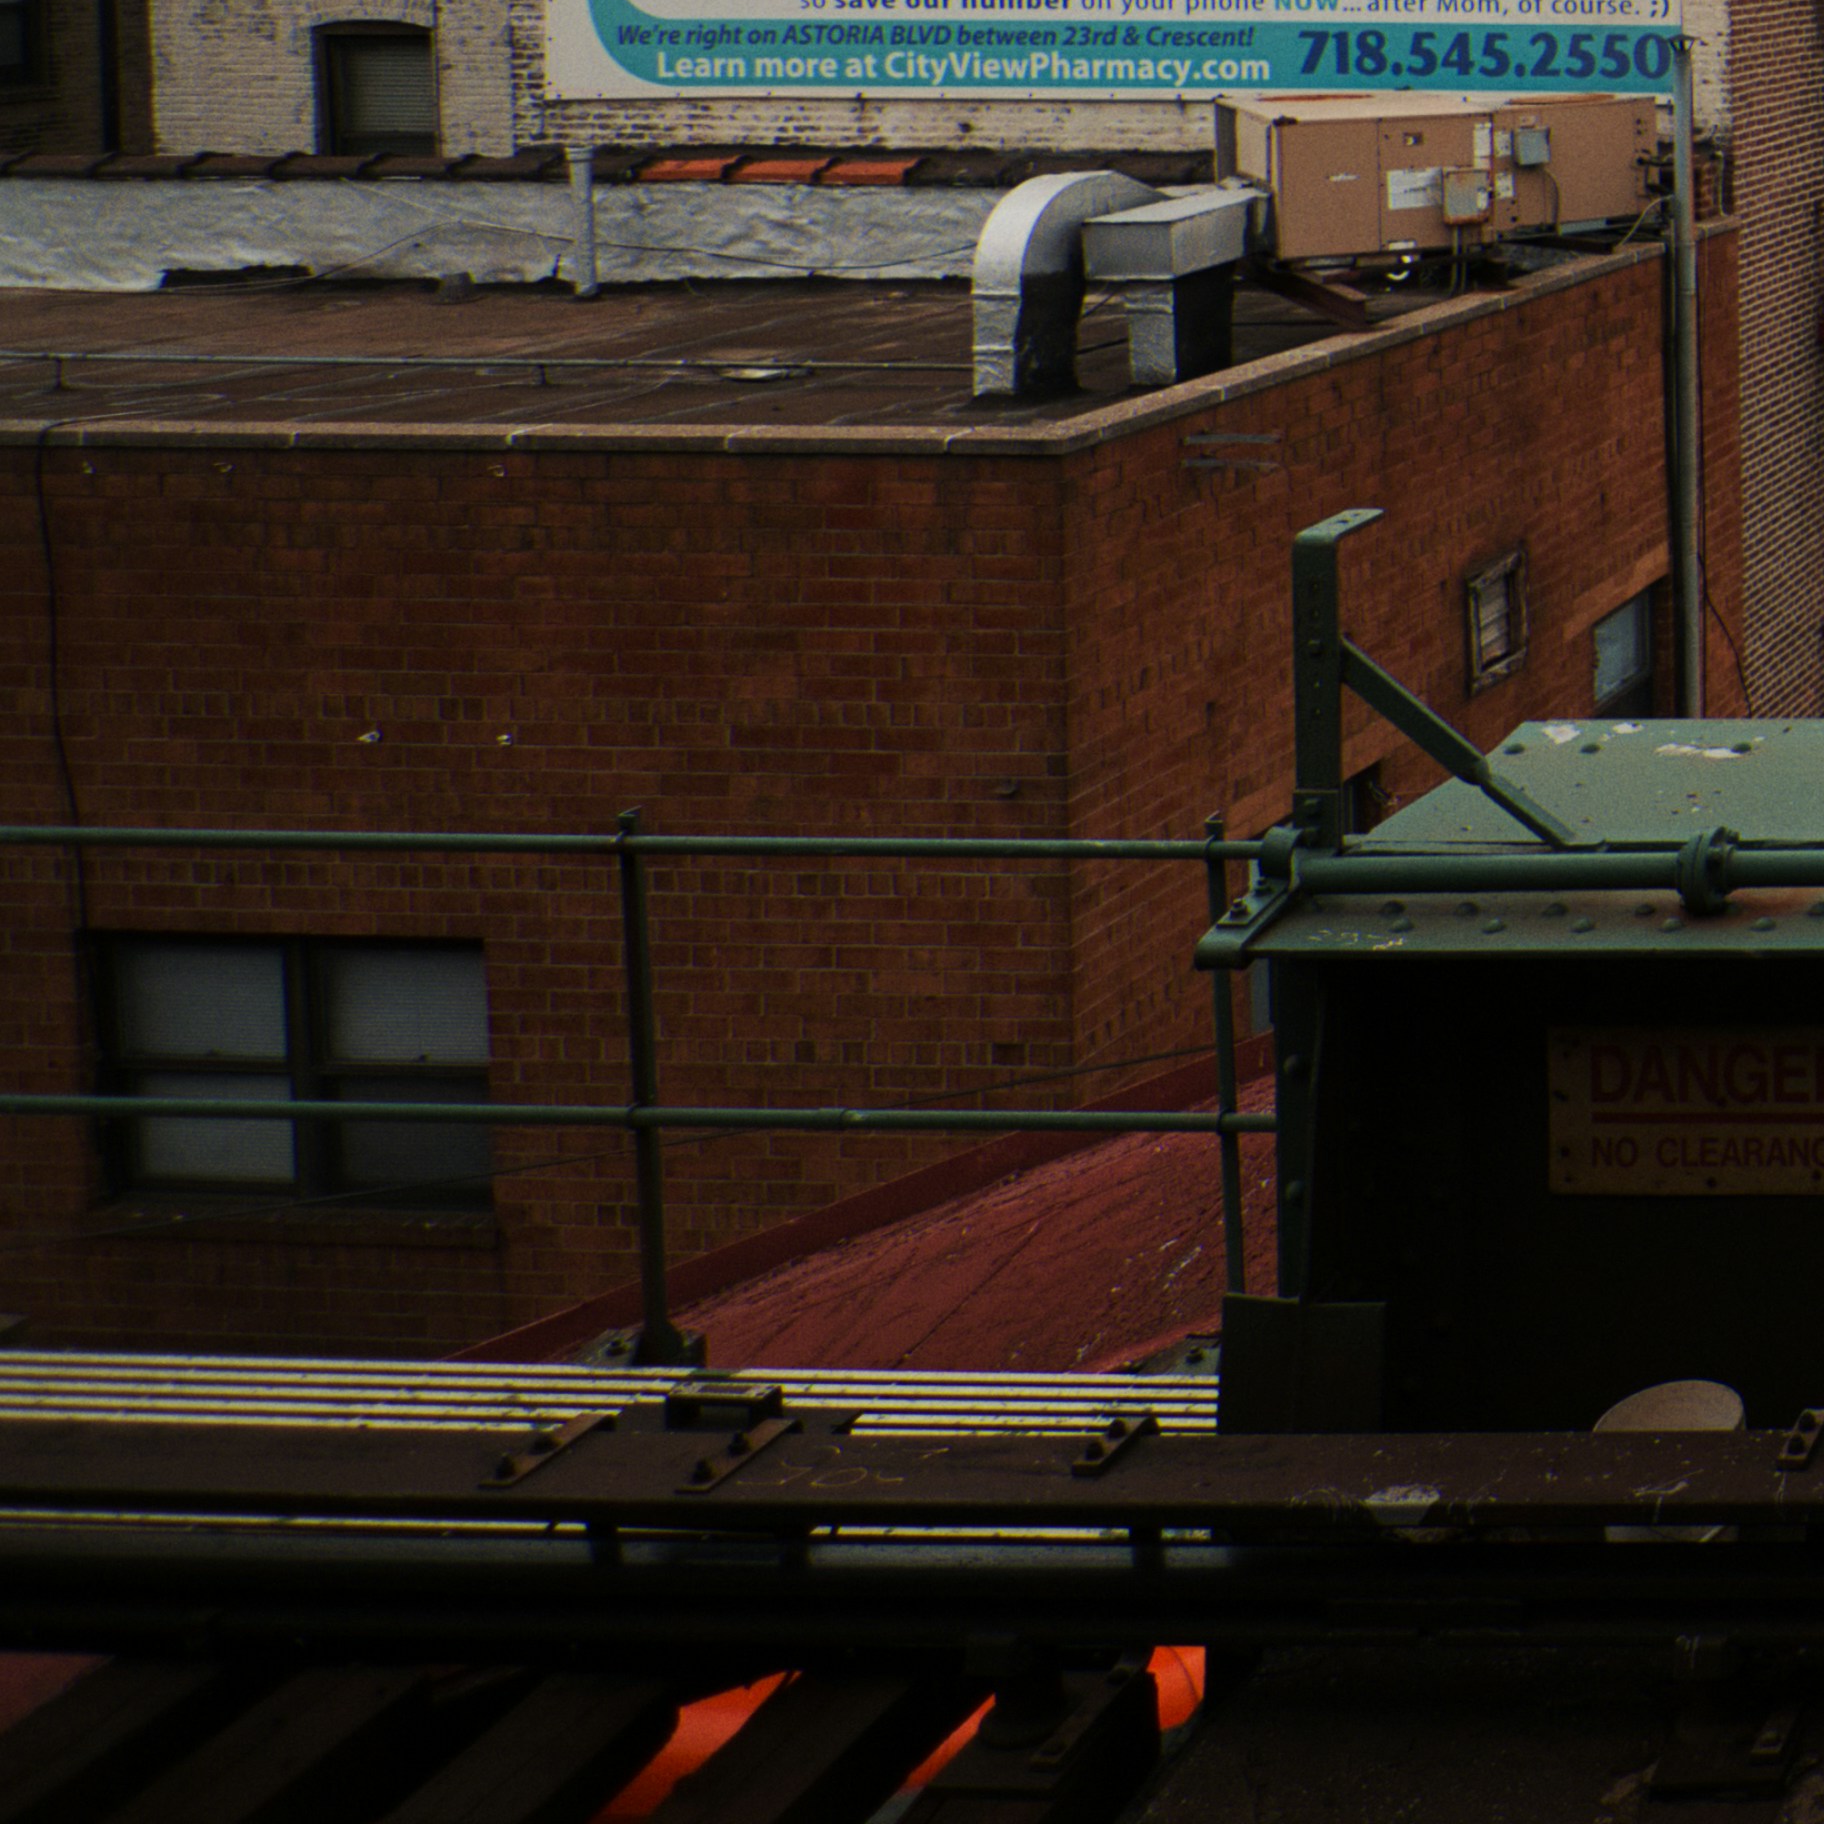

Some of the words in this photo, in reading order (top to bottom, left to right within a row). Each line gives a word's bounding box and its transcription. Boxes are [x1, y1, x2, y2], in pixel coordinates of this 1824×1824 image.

[1550, 0, 1640, 16] course.
[686, 25, 744, 50] right
[748, 30, 777, 46] on
[782, 25, 886, 46] ASTORIA
[890, 26, 954, 46] BLVD
[957, 26, 1058, 47] between
[1062, 26, 1118, 47] 23rd
[1122, 28, 1140, 47] &
[1145, 26, 1255, 48] Crescent!
[1298, 28, 1672, 80] 718.545.2550
[657, 51, 749, 79] Learn
[755, 58, 839, 79] more
[844, 54, 877, 80] at
[884, 52, 1271, 87] CityViewPharmacy.com
[1592, 1135, 1640, 1169] NO
